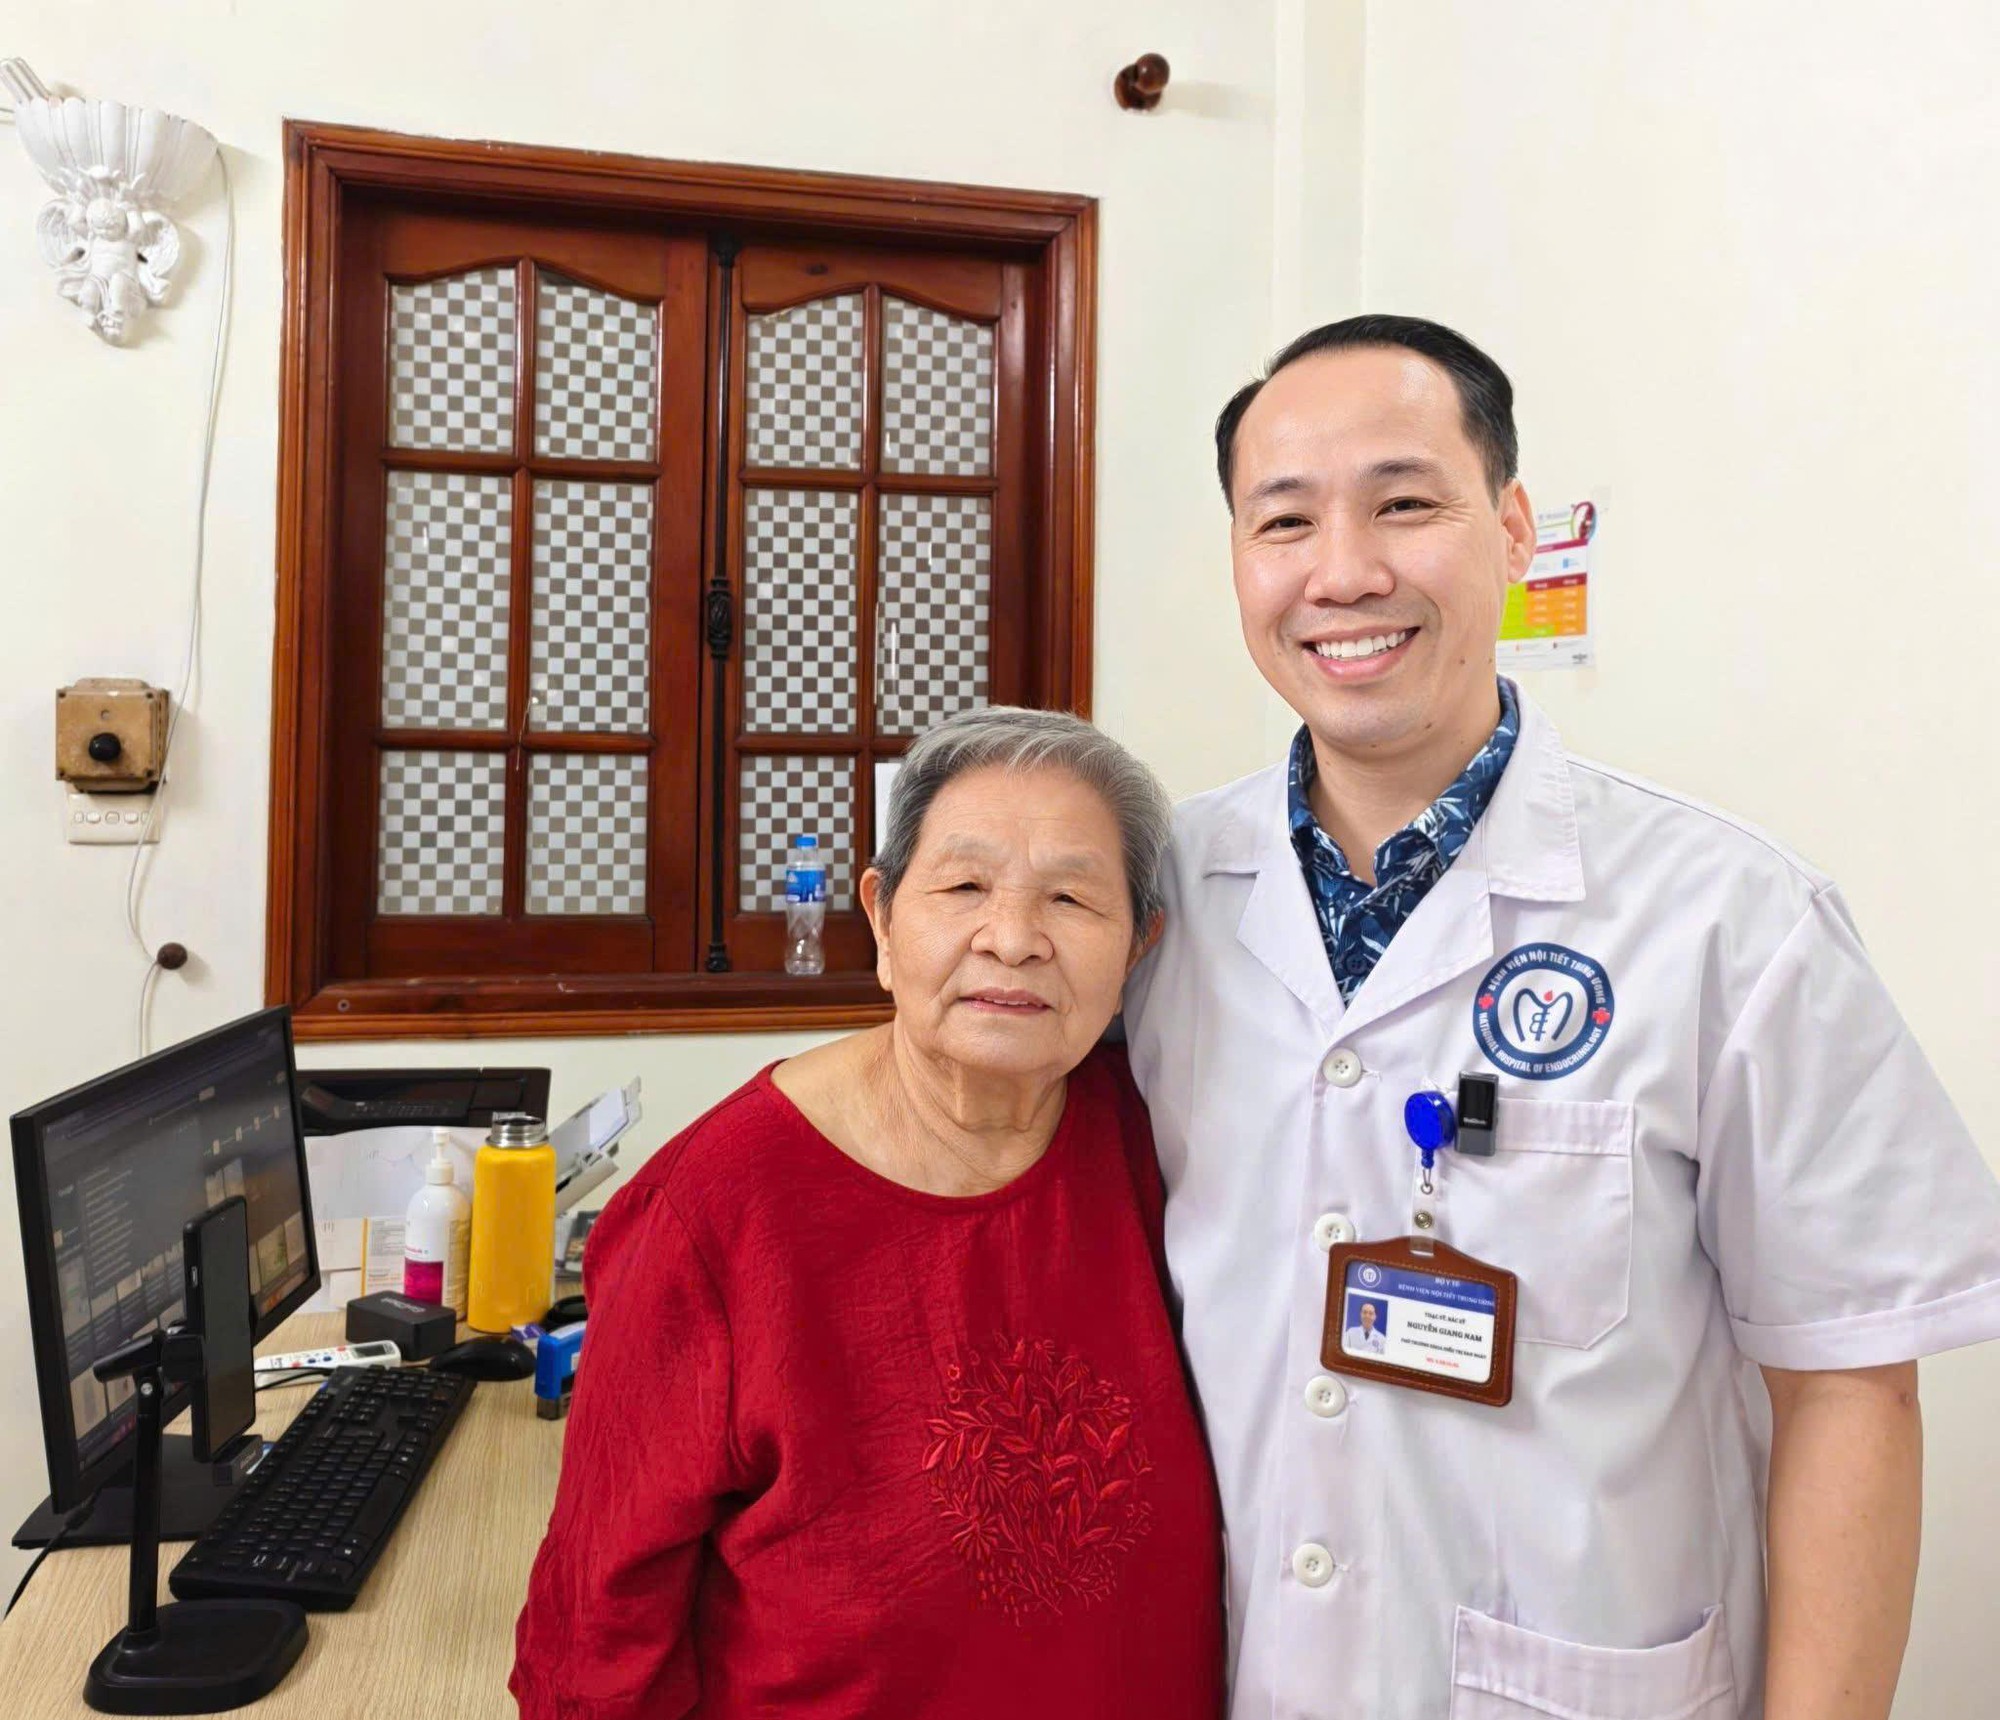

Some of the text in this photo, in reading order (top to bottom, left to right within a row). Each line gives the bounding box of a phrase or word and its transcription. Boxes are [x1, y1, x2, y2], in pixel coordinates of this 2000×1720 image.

[1505, 953, 1529, 970] VIỆN
[1528, 949, 1547, 963] NỘI
[1549, 951, 1571, 966] TIẾT
[1478, 1012, 1603, 1073] NATIONAL HOSPITAL OF ENDOCRINOLOGY
[1407, 1321, 1482, 1342] NGUYỄN GIANG NAM
